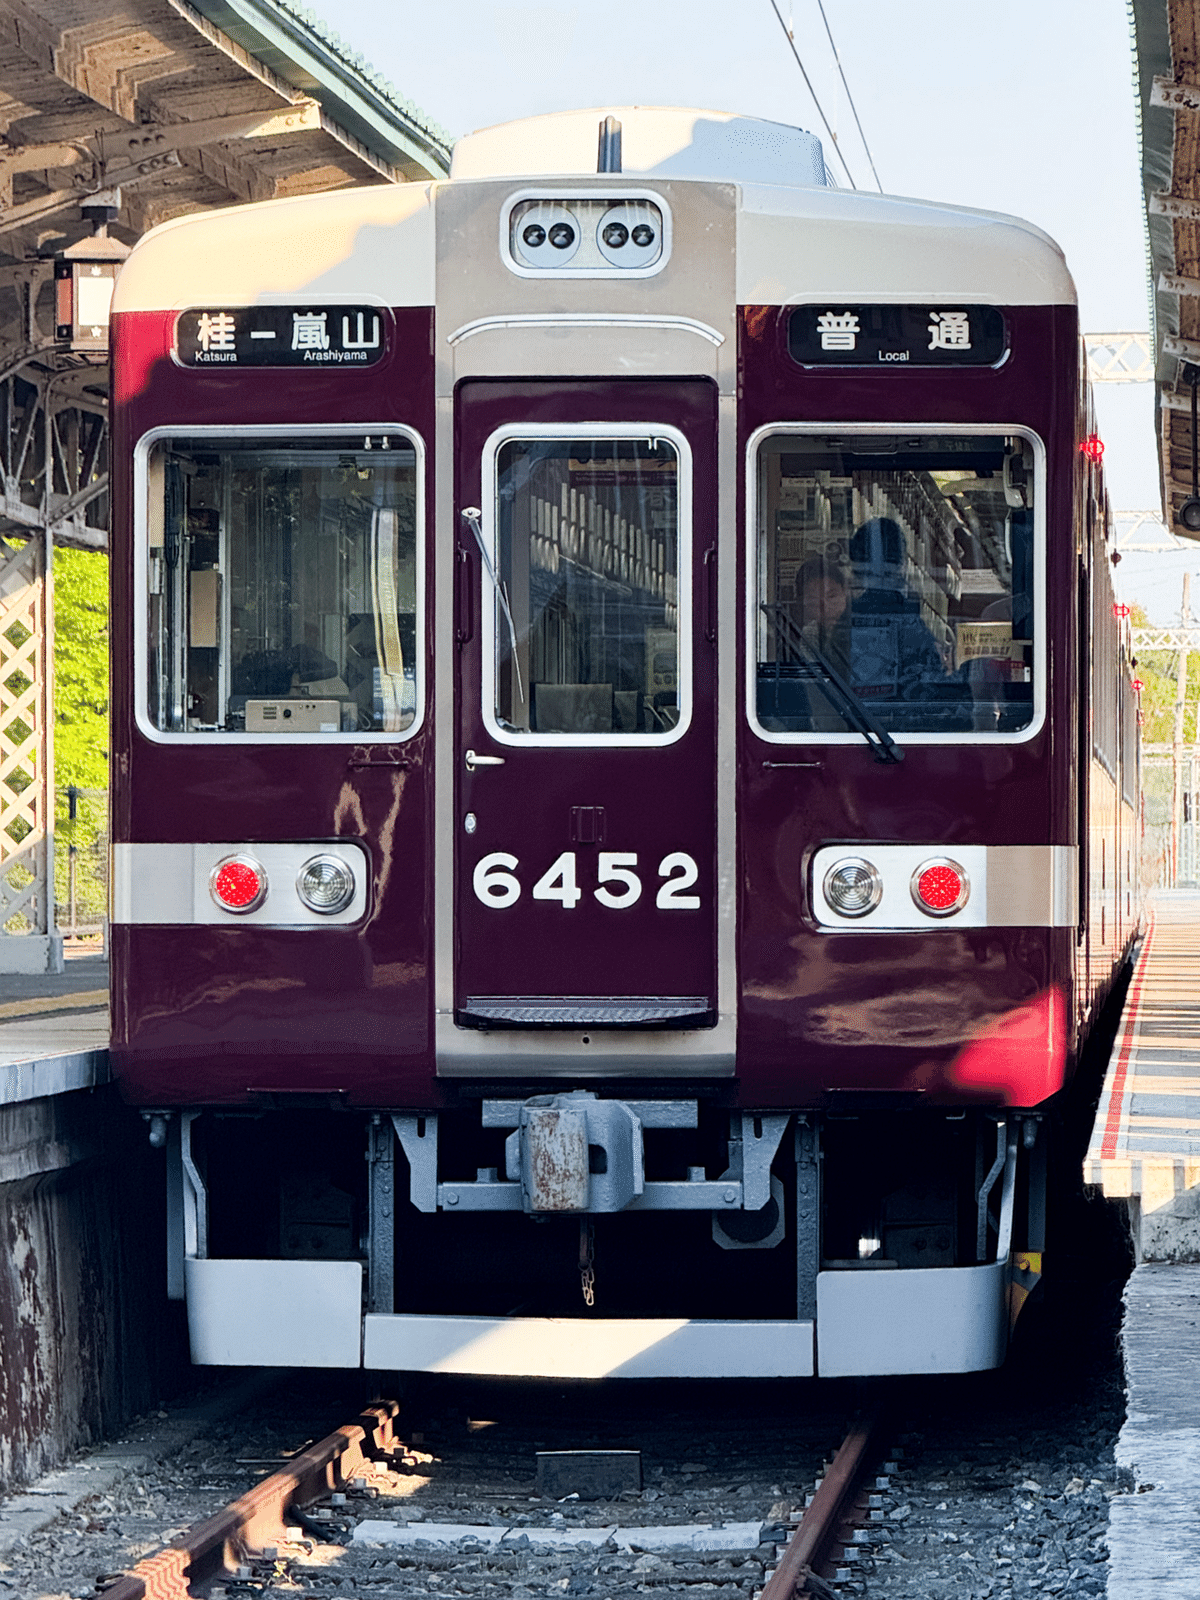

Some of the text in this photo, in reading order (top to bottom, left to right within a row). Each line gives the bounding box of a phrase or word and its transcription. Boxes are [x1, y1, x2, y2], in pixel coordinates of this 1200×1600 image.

[816, 312, 972, 351] 普通
[195, 350, 368, 363] Katsura Arashiyama
[878, 350, 910, 362] Local
[472, 851, 701, 910] 6452
